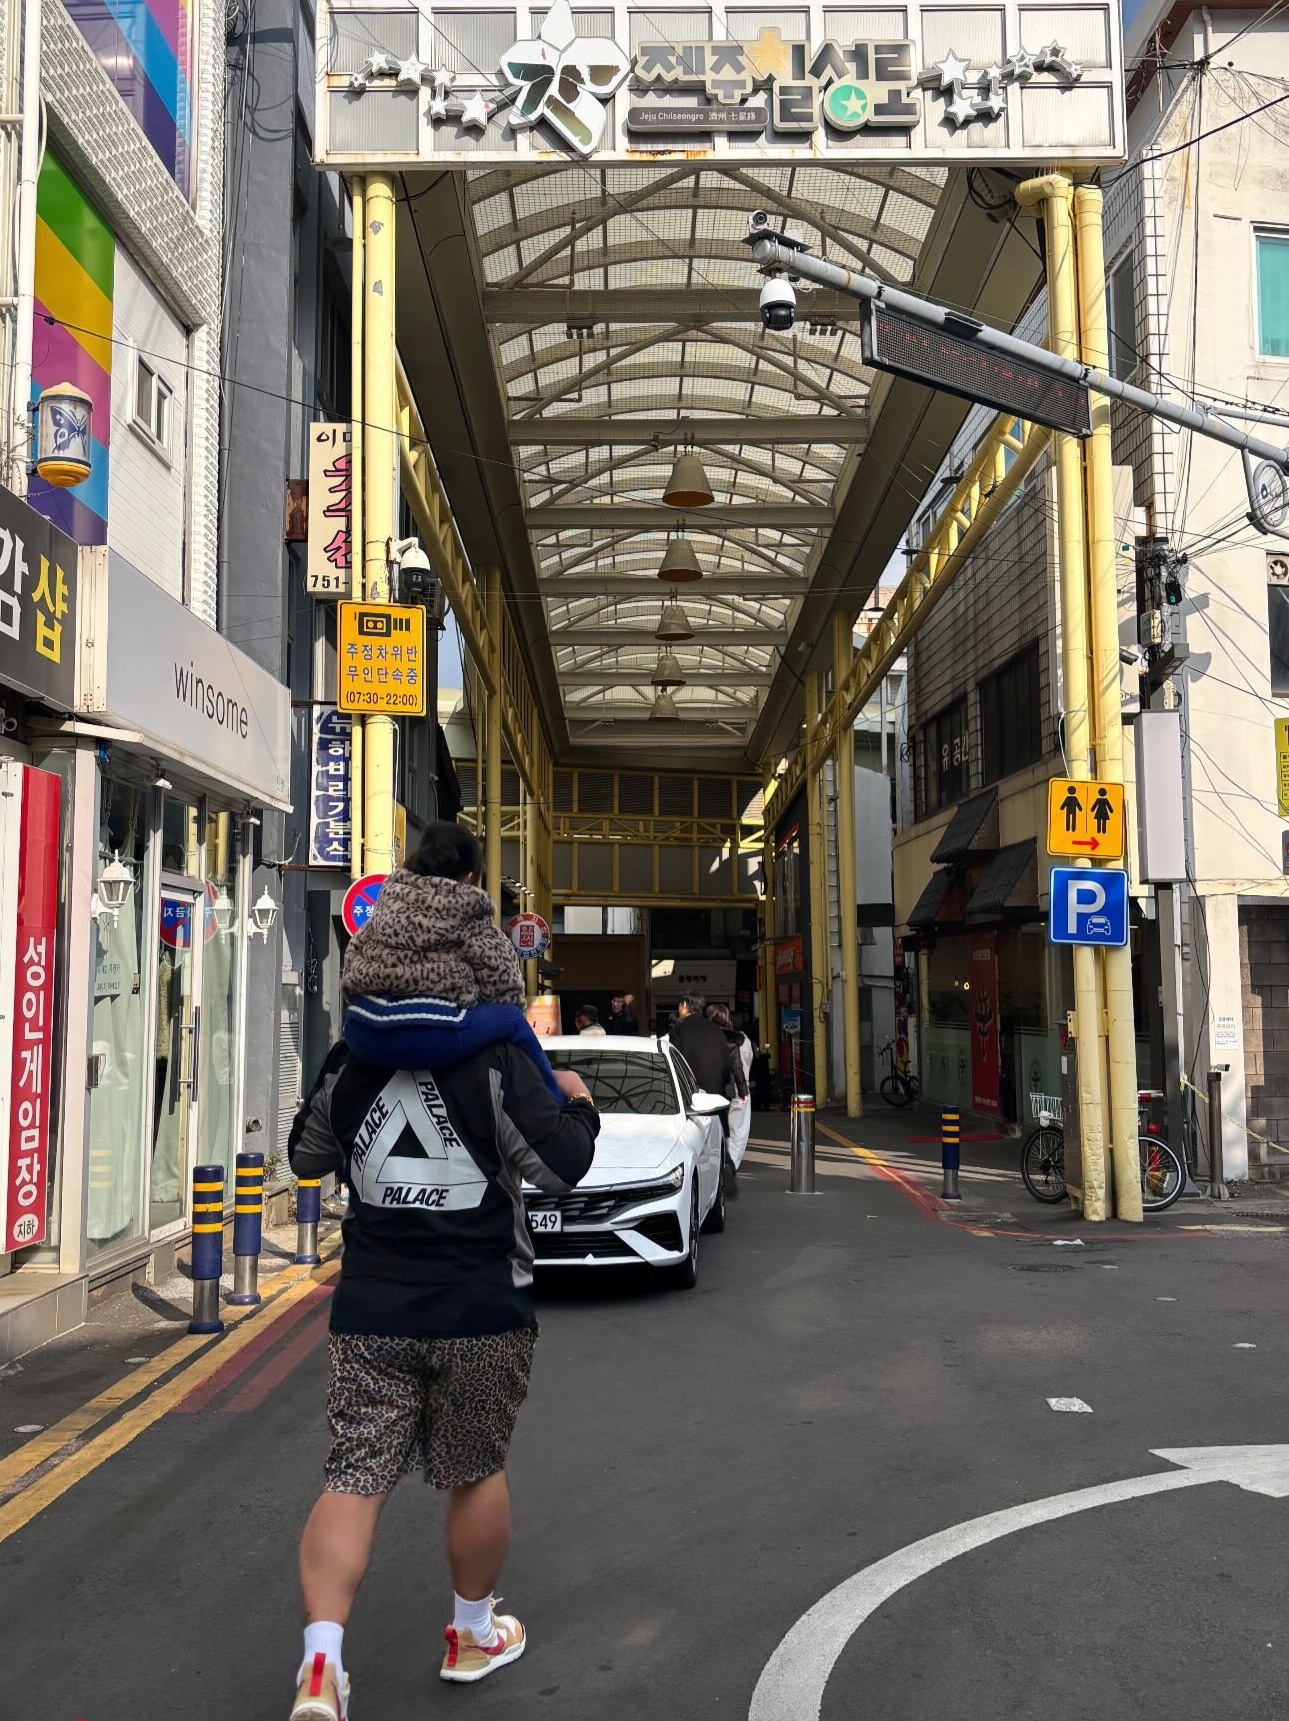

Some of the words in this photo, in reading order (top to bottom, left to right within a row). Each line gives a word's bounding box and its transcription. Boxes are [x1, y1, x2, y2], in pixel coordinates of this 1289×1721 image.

[640, 45, 747, 100] 제주
[751, 29, 918, 124] 칠성로
[640, 112, 656, 121] Jeju
[658, 112, 704, 121] Chilseongro
[346, 643, 418, 662] 주정차위반
[346, 665, 419, 685] 무인단속중
[174, 660, 248, 739] winsome
[346, 691, 418, 707] (07:30~22:00)
[1067, 880, 1106, 934] P
[15, 937, 47, 1207] 성인게임장
[418, 1081, 461, 1148] PALACE
[352, 1095, 389, 1172] PALACE
[381, 1186, 450, 1207] PALACE
[16, 1219, 36, 1240] 지하
